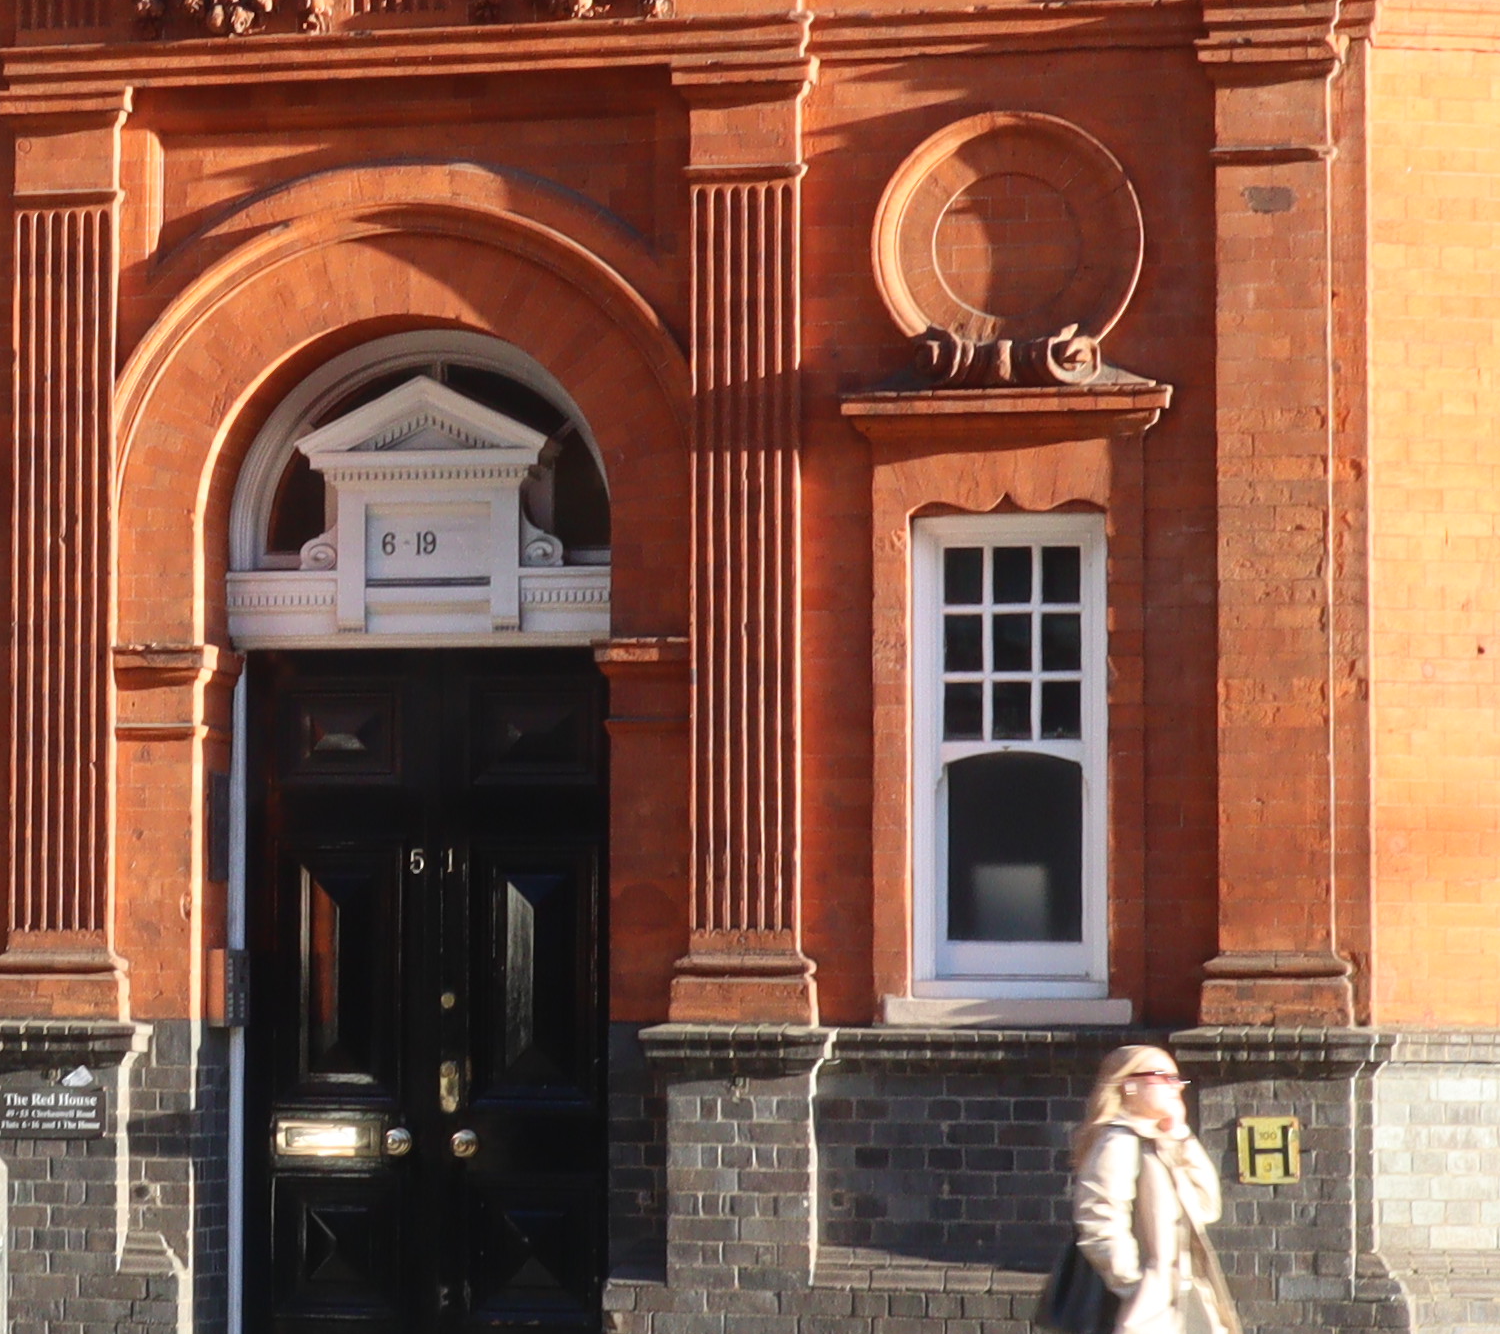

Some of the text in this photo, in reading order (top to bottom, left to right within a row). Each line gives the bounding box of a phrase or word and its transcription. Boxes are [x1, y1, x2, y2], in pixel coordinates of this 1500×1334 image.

[3, 1092, 98, 1107] The Red House
[1247, 1125, 1291, 1178] H
